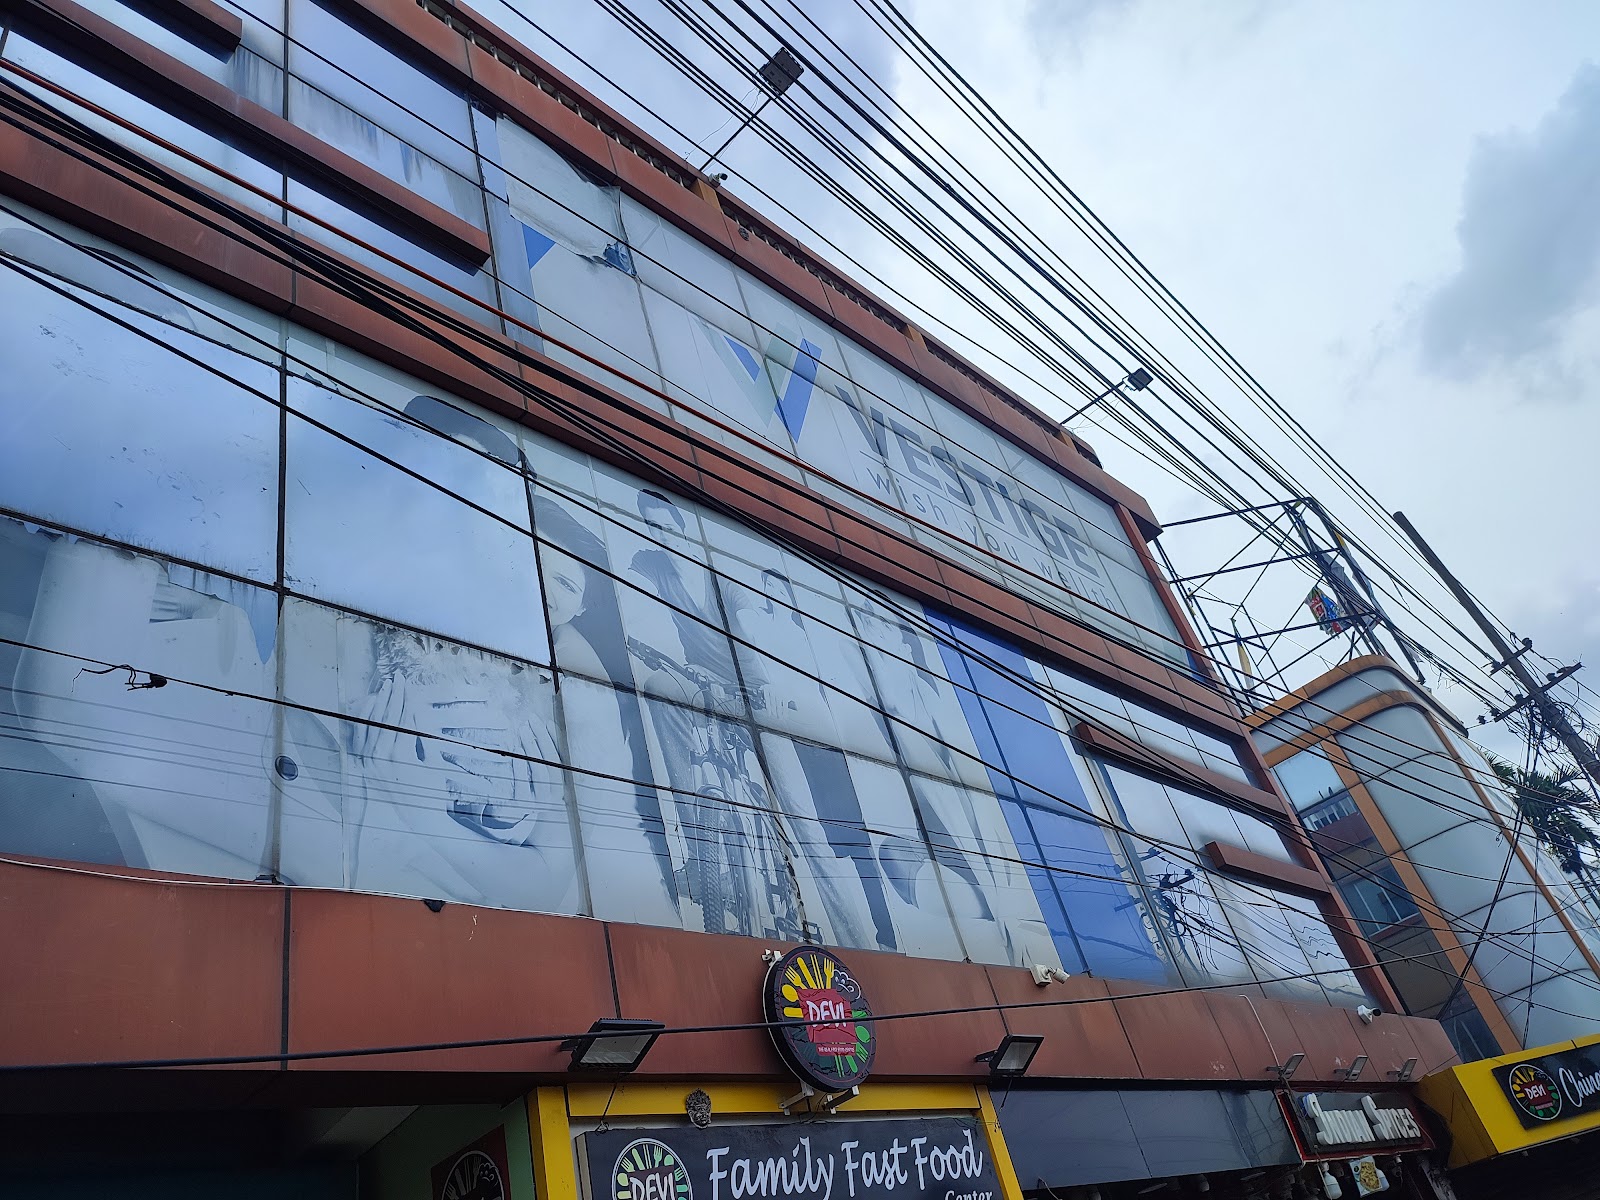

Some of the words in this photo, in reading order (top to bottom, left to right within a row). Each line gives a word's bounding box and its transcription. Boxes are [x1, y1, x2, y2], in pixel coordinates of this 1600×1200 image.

[835, 385, 1100, 578] VESTIGE
[866, 467, 948, 525] wish
[964, 520, 1020, 563] you
[806, 1000, 847, 1028] DEVI
[1524, 1084, 1547, 1100] DEVI
[629, 1172, 676, 1200] DEVI
[706, 1136, 834, 1200] Family
[841, 1137, 908, 1198] Fast
[910, 1128, 983, 1190] Food
